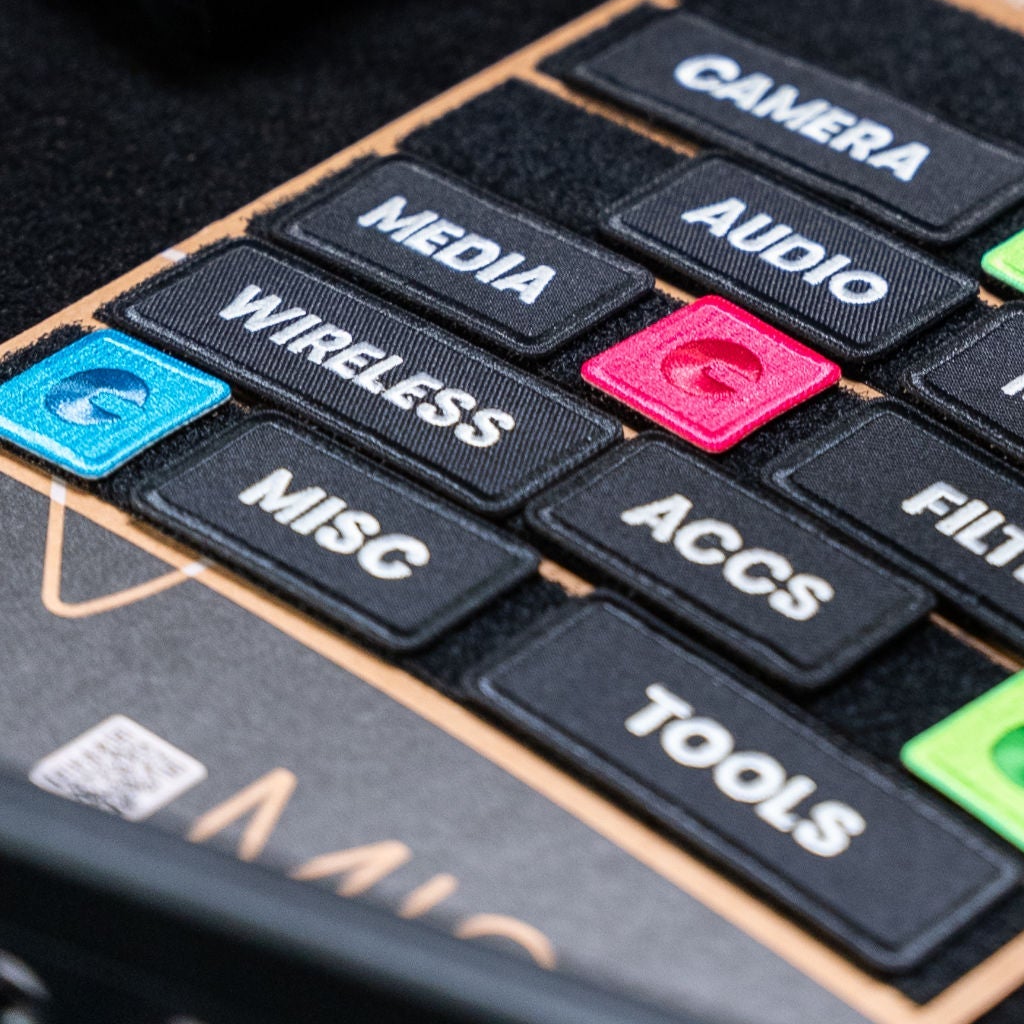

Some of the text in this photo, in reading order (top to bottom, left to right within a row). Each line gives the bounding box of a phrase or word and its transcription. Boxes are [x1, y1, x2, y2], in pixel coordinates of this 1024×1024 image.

[675, 55, 931, 182] CAMERA
[358, 196, 557, 305] MEDIA
[681, 198, 889, 306] AUDIO
[218, 284, 515, 449] WIRELESS
[238, 467, 431, 581] MISC
[621, 494, 835, 621] ACCS
[625, 683, 867, 859] TOOLS
